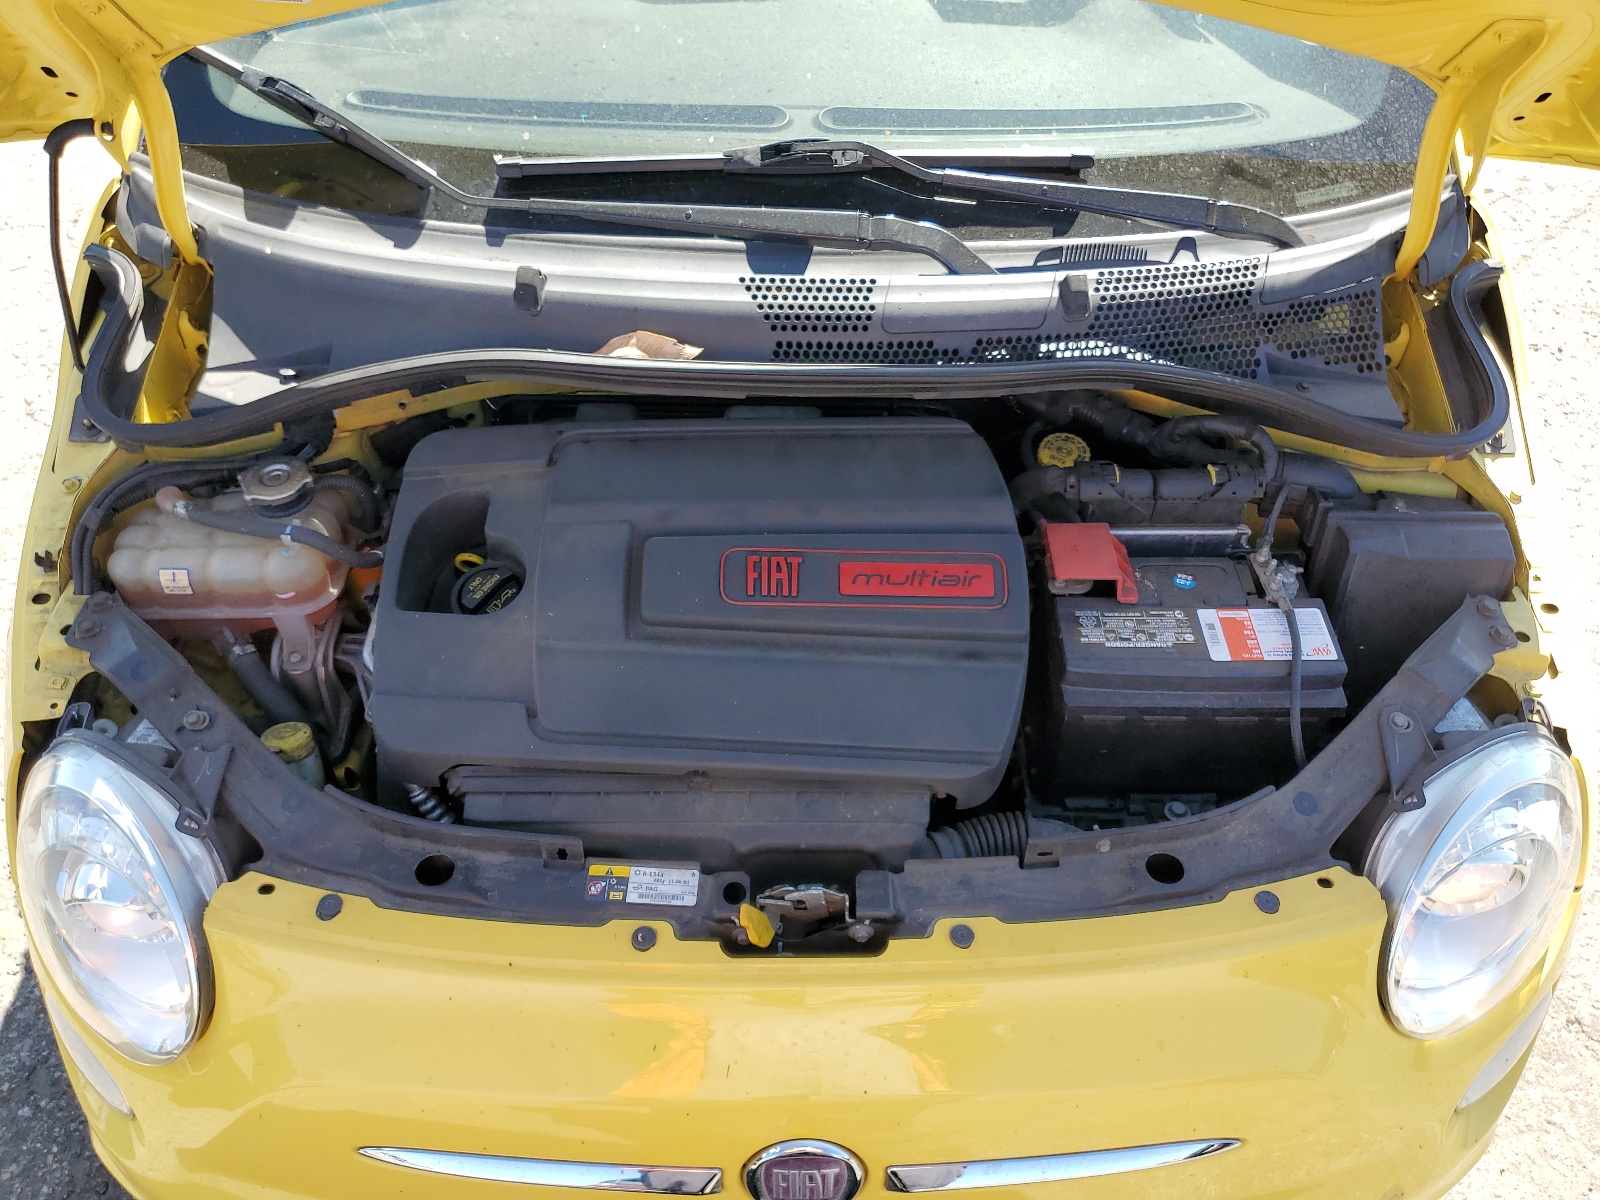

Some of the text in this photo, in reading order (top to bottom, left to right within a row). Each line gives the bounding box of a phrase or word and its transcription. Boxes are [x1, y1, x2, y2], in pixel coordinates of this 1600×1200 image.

[468, 577, 483, 591] ONLY
[745, 555, 804, 597] FIAT
[850, 569, 983, 589] multiair
[642, 870, 664, 878] R-134a
[771, 1168, 841, 1200] FIAT
